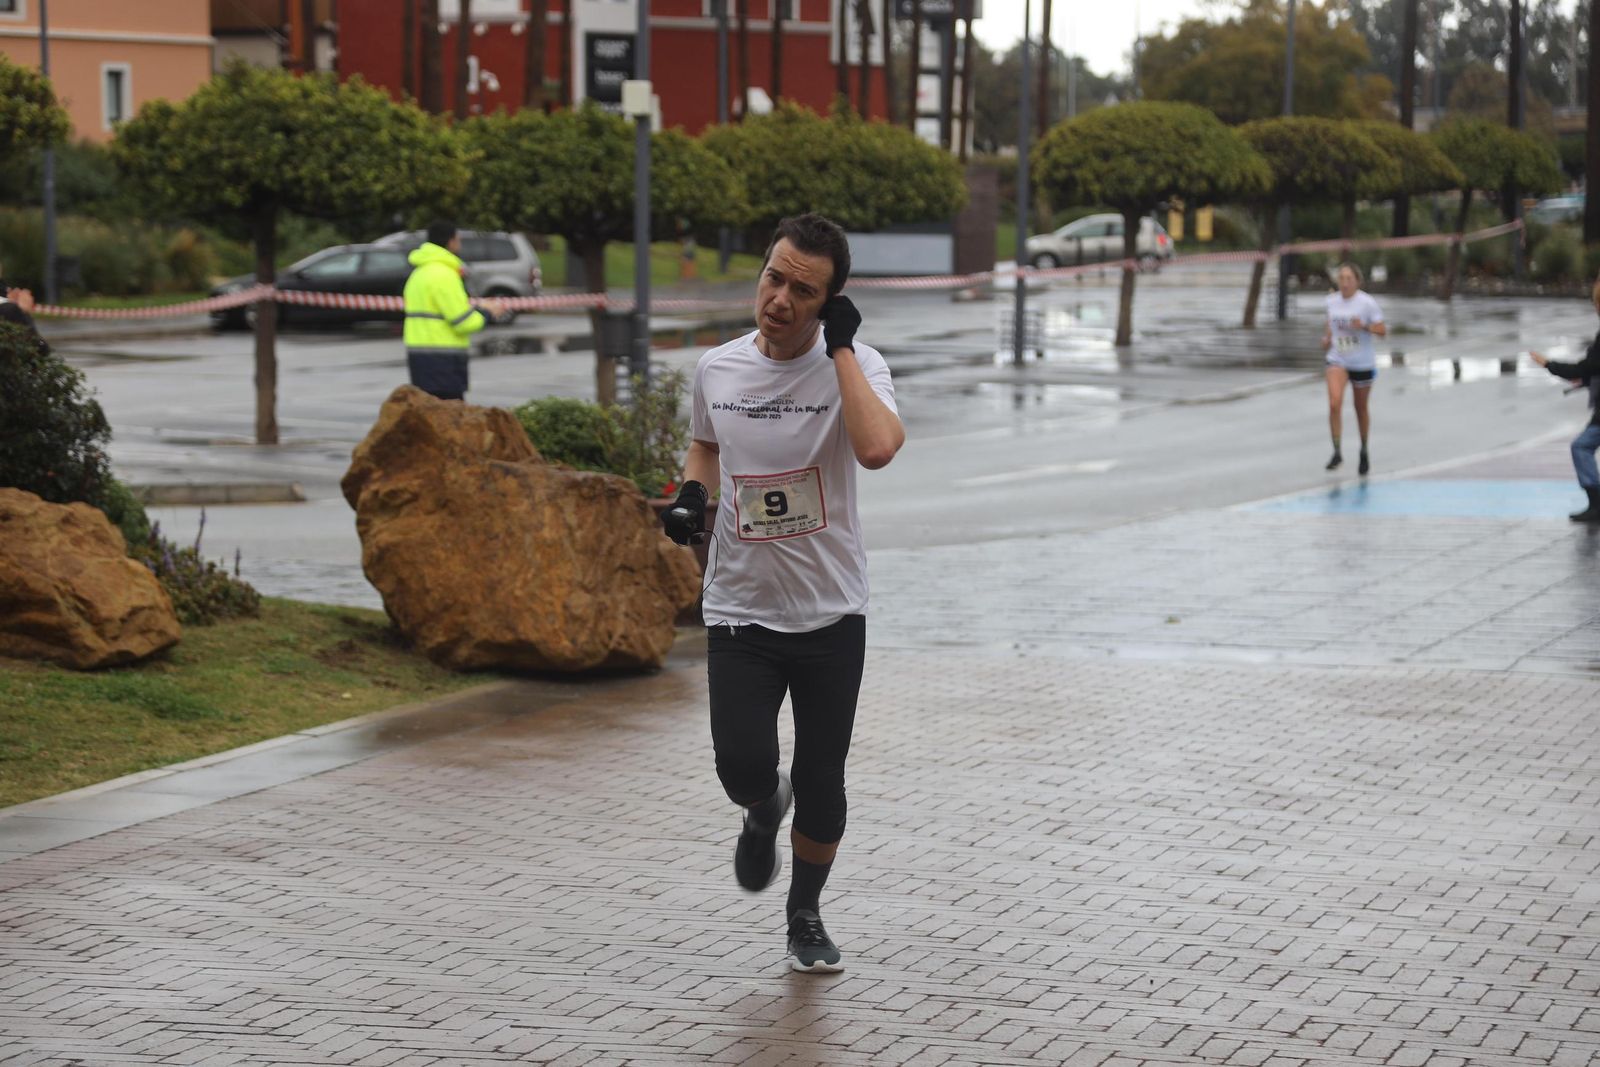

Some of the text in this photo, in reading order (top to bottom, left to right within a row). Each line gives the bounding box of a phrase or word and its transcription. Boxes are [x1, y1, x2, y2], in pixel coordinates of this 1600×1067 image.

[722, 402, 781, 413] Internacional
[783, 405, 794, 413] de
[795, 405, 803, 413] la
[805, 404, 830, 415] Mujer
[764, 490, 788, 517] 9
